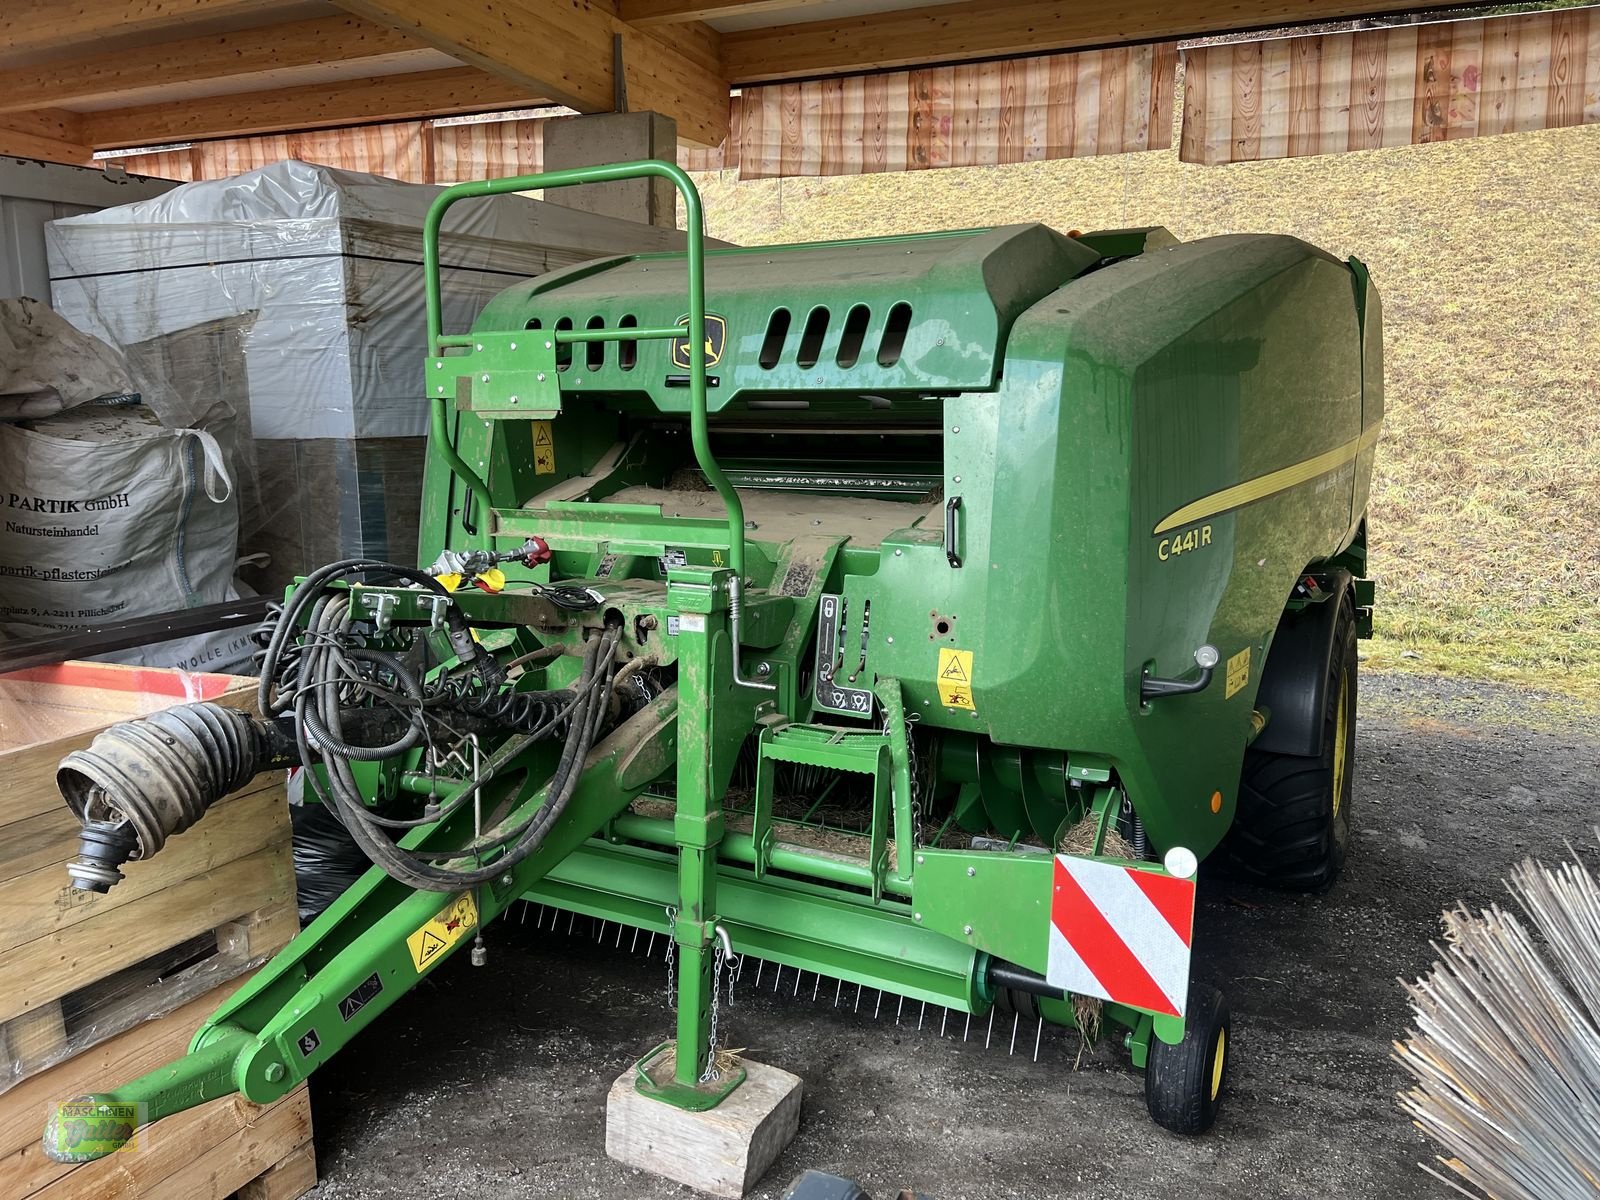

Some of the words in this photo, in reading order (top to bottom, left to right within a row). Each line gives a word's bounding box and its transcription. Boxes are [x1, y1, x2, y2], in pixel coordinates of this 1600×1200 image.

[8, 493, 80, 513] PARTIK
[84, 493, 130, 511] GmbH
[6, 521, 99, 537] Natursteinhandel
[177, 648, 222, 670] WOLLE
